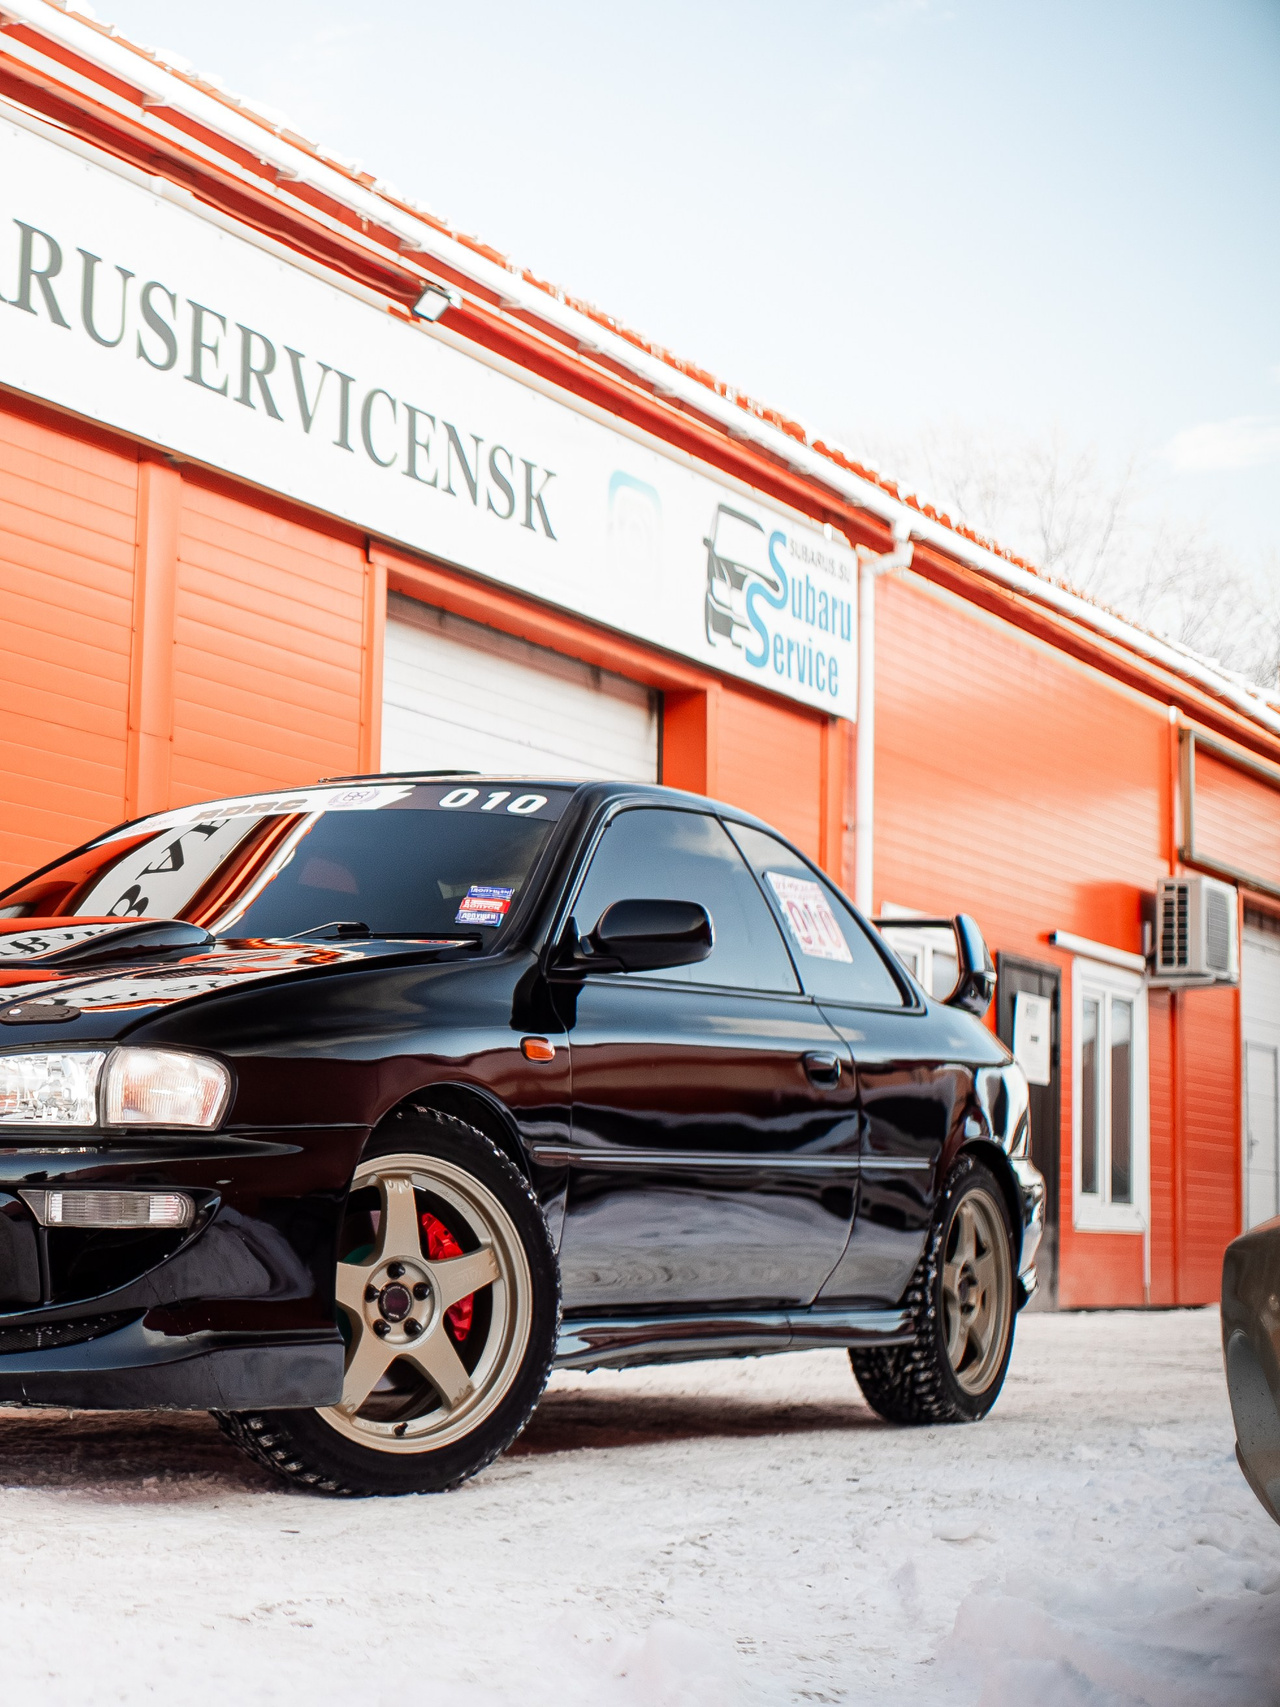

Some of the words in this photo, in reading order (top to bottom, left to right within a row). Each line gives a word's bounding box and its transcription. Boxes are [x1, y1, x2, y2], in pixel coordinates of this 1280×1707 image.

[745, 582, 839, 698] Service
[768, 530, 852, 642] Subaru
[438, 787, 548, 814] 010
